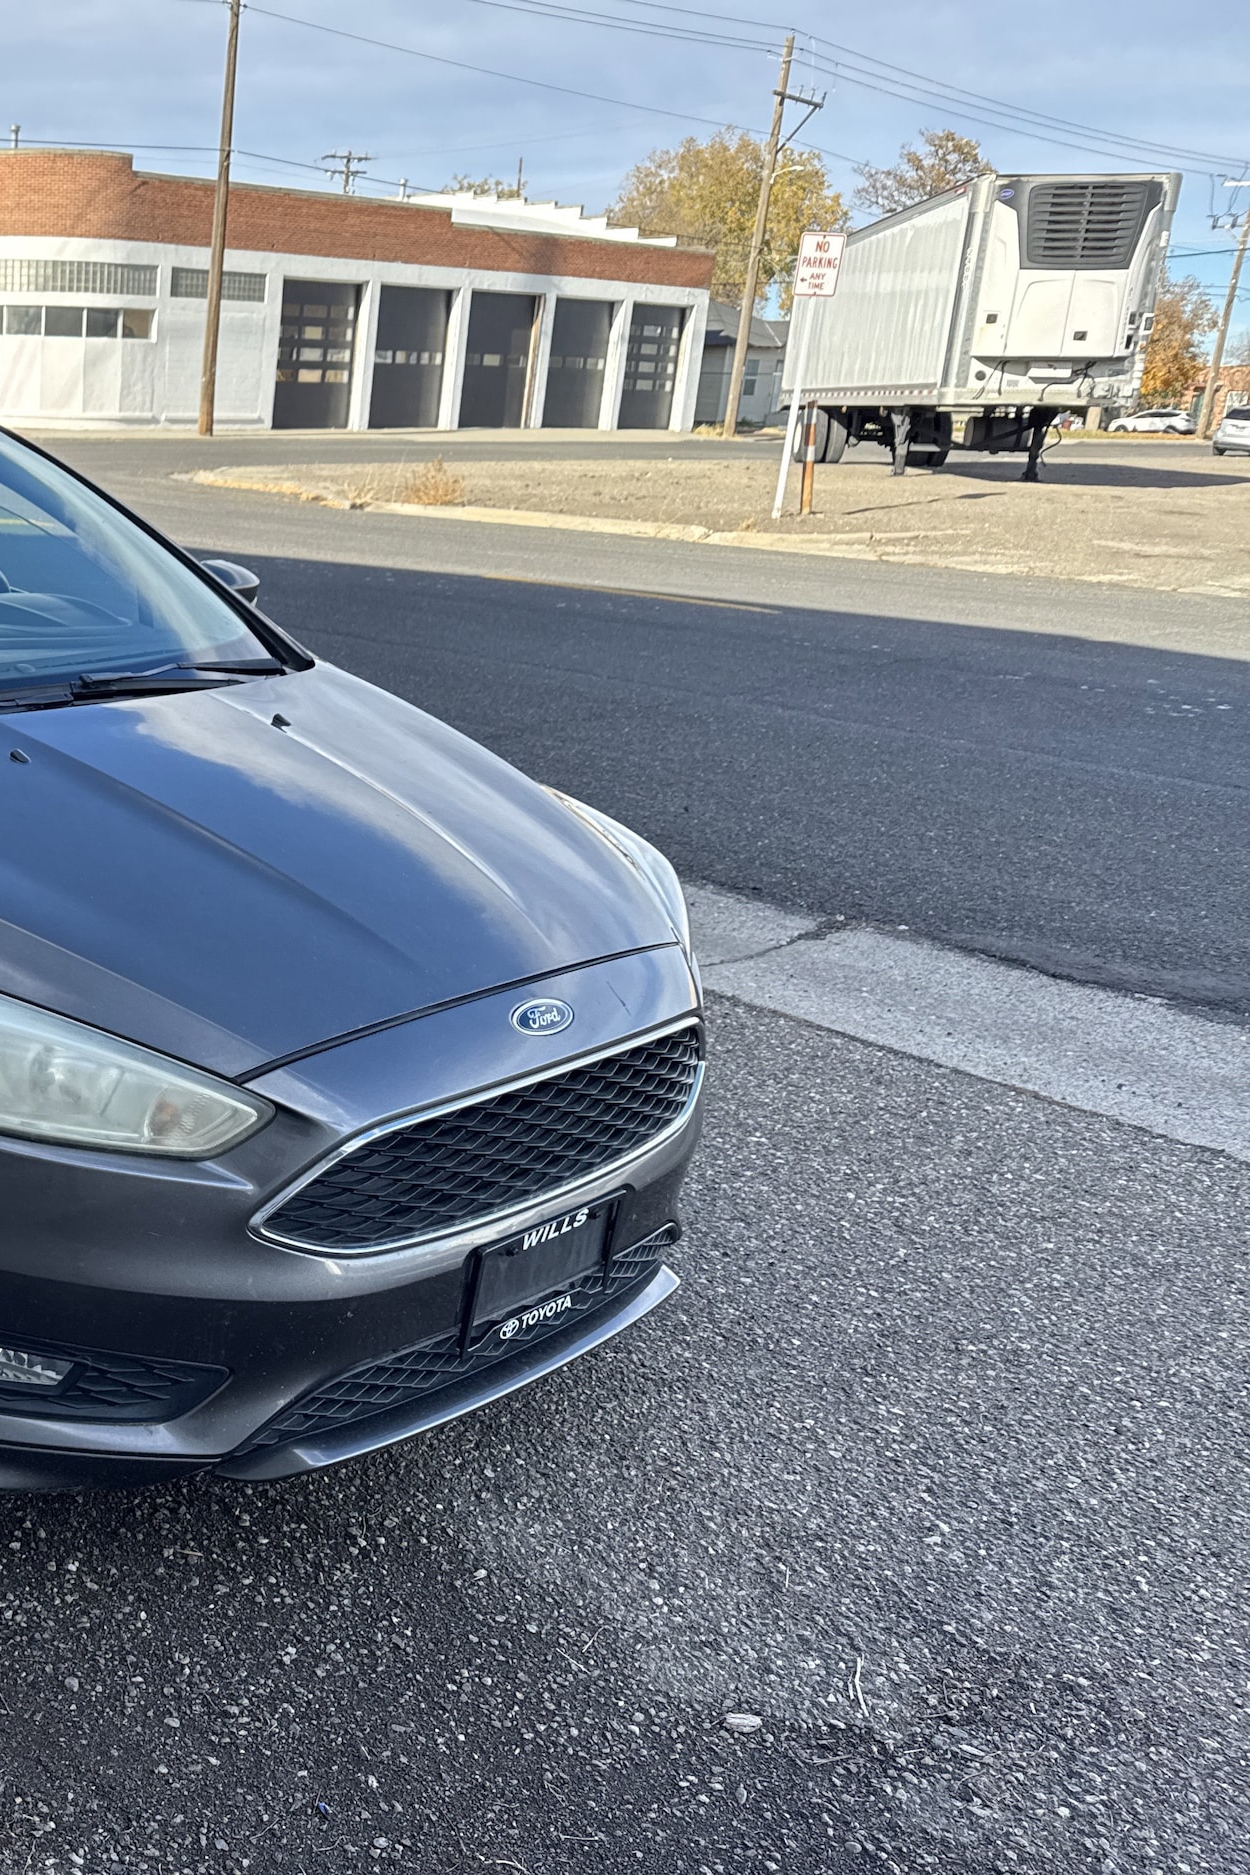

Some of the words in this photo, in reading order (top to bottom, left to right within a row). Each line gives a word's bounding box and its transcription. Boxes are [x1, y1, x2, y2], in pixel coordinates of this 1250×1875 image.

[815, 241, 831, 253] NO
[802, 256, 838, 269] PARKING
[809, 272, 827, 280] ANY
[807, 281, 825, 290] TIME
[527, 1005, 561, 1029] Ford
[521, 1207, 590, 1252] WILLS
[521, 1295, 572, 1329] TOYOTA
